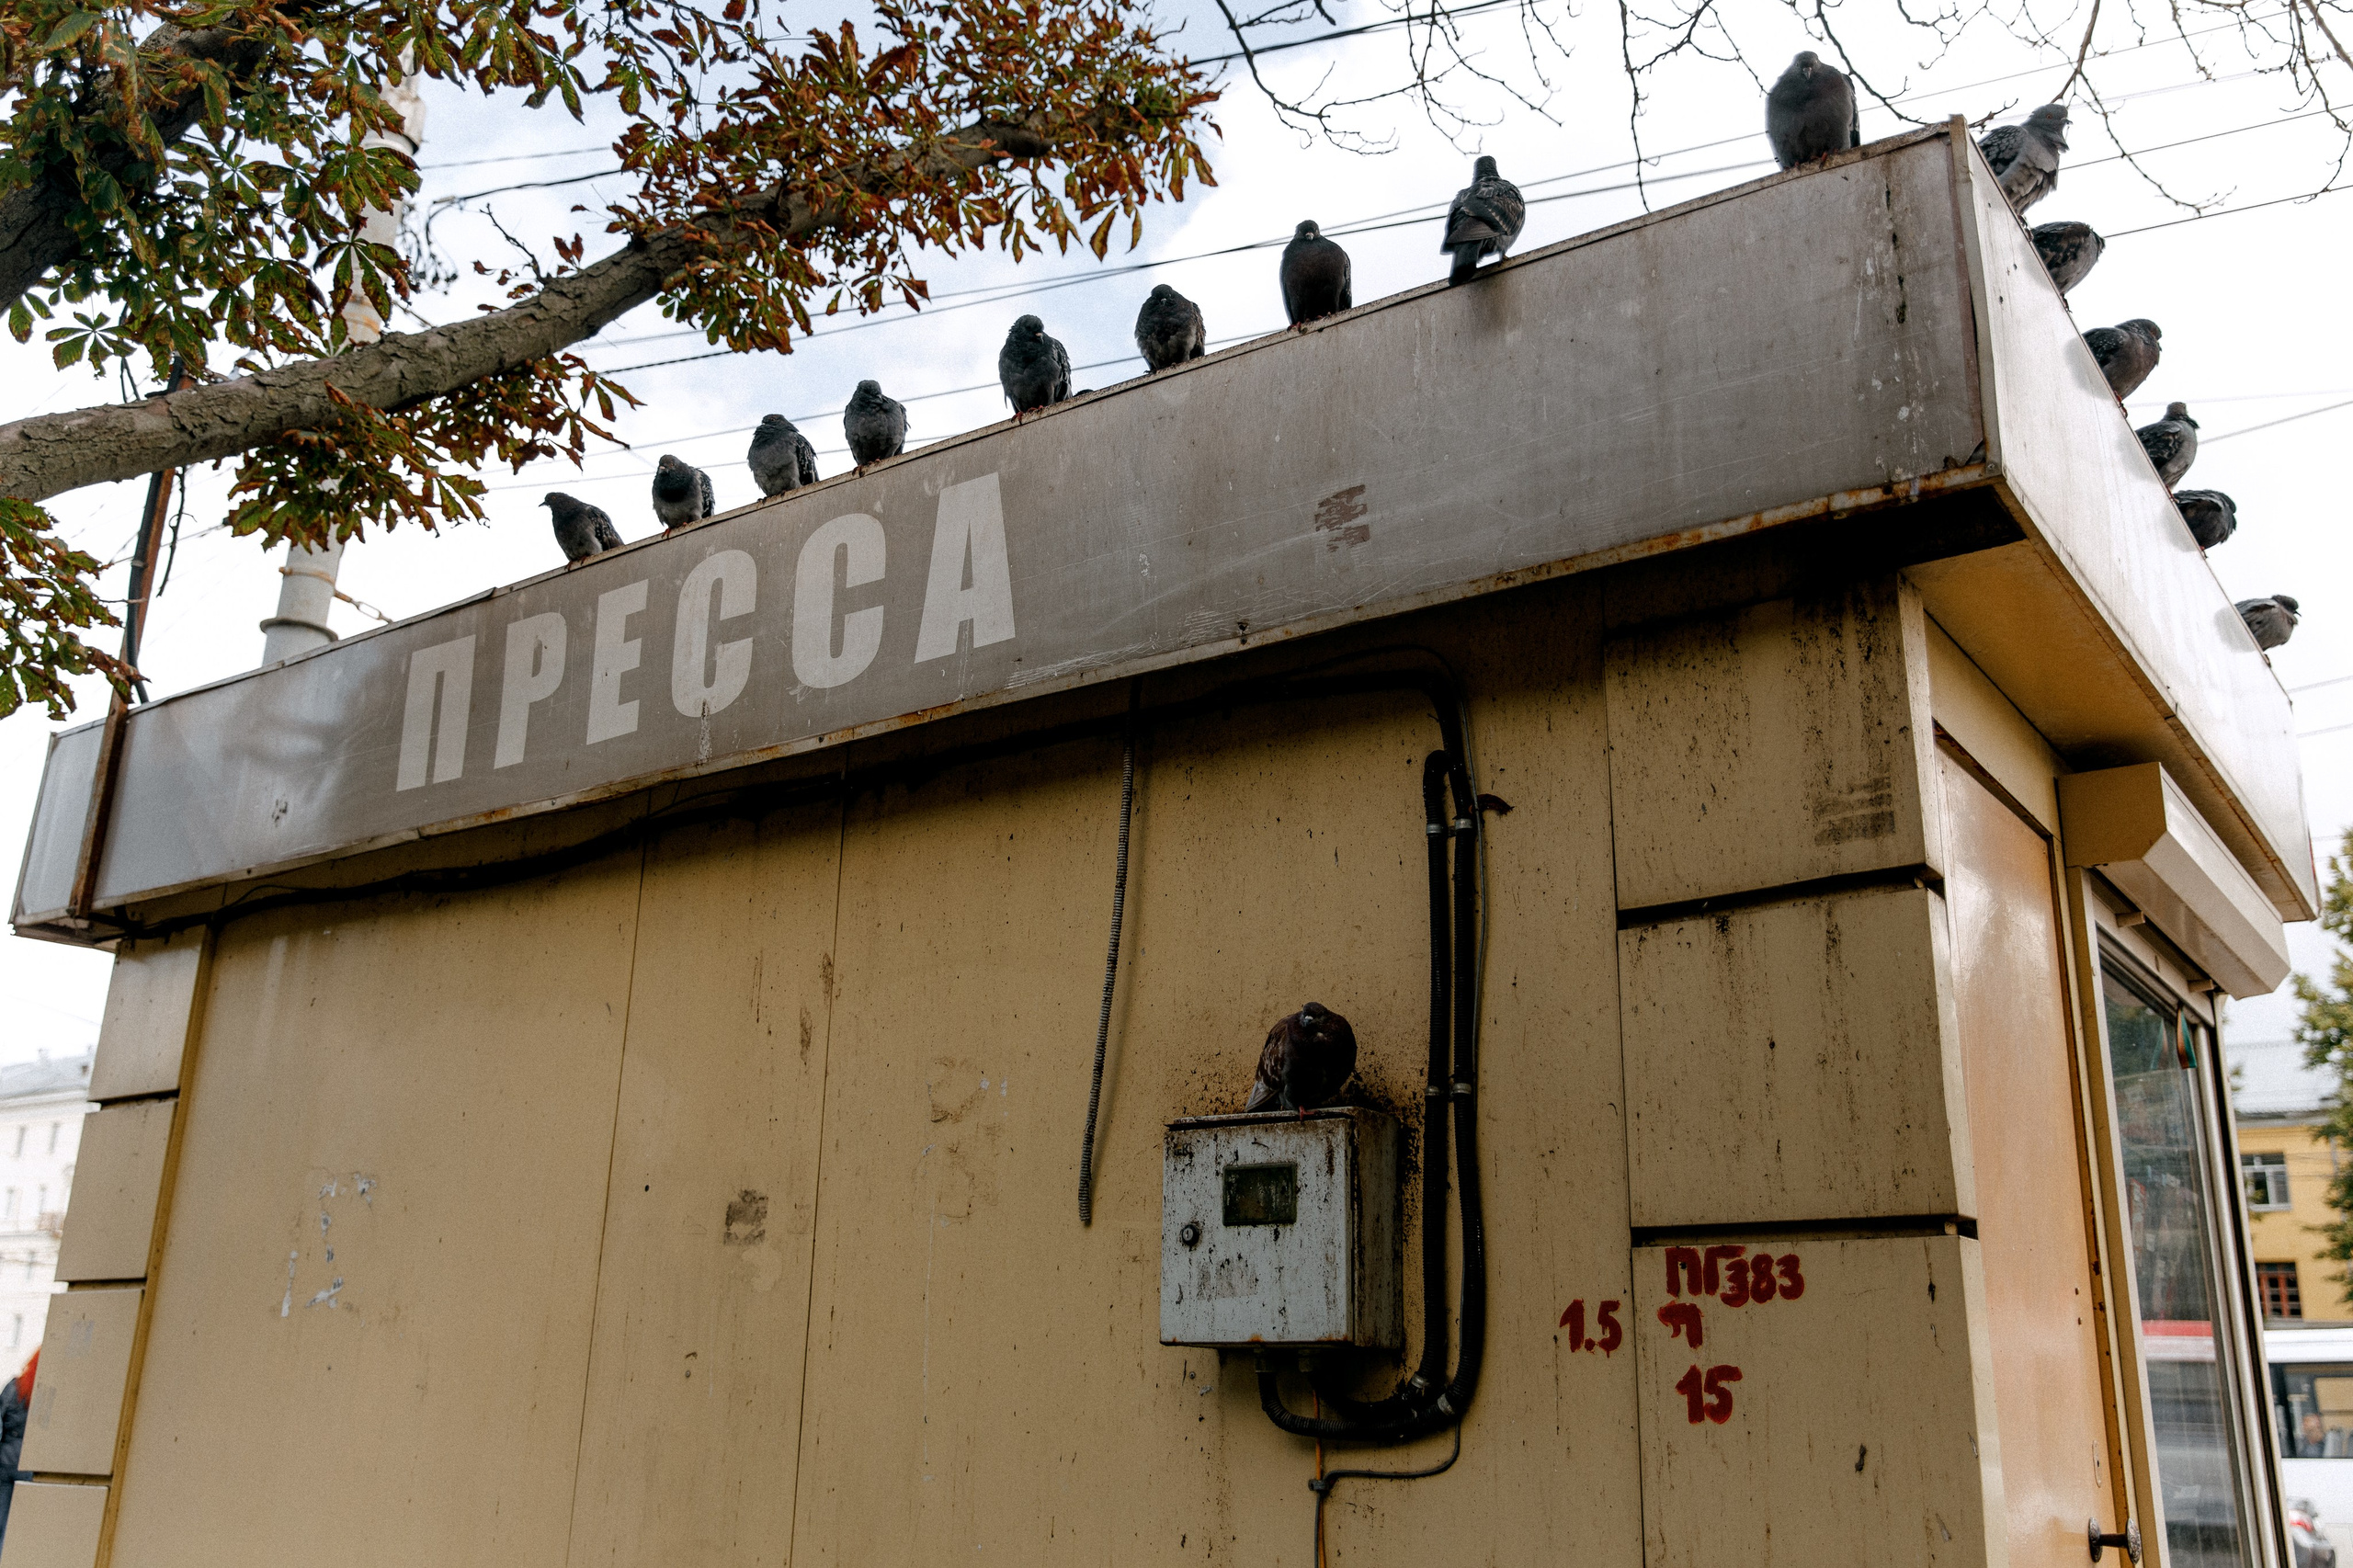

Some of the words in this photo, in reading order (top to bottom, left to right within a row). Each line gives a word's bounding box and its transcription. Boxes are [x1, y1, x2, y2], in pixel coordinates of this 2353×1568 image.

[396, 472, 1017, 792] ПРЕССА
[1559, 1298, 1623, 1357] 1.5
[1675, 1364, 1744, 1425] 15
